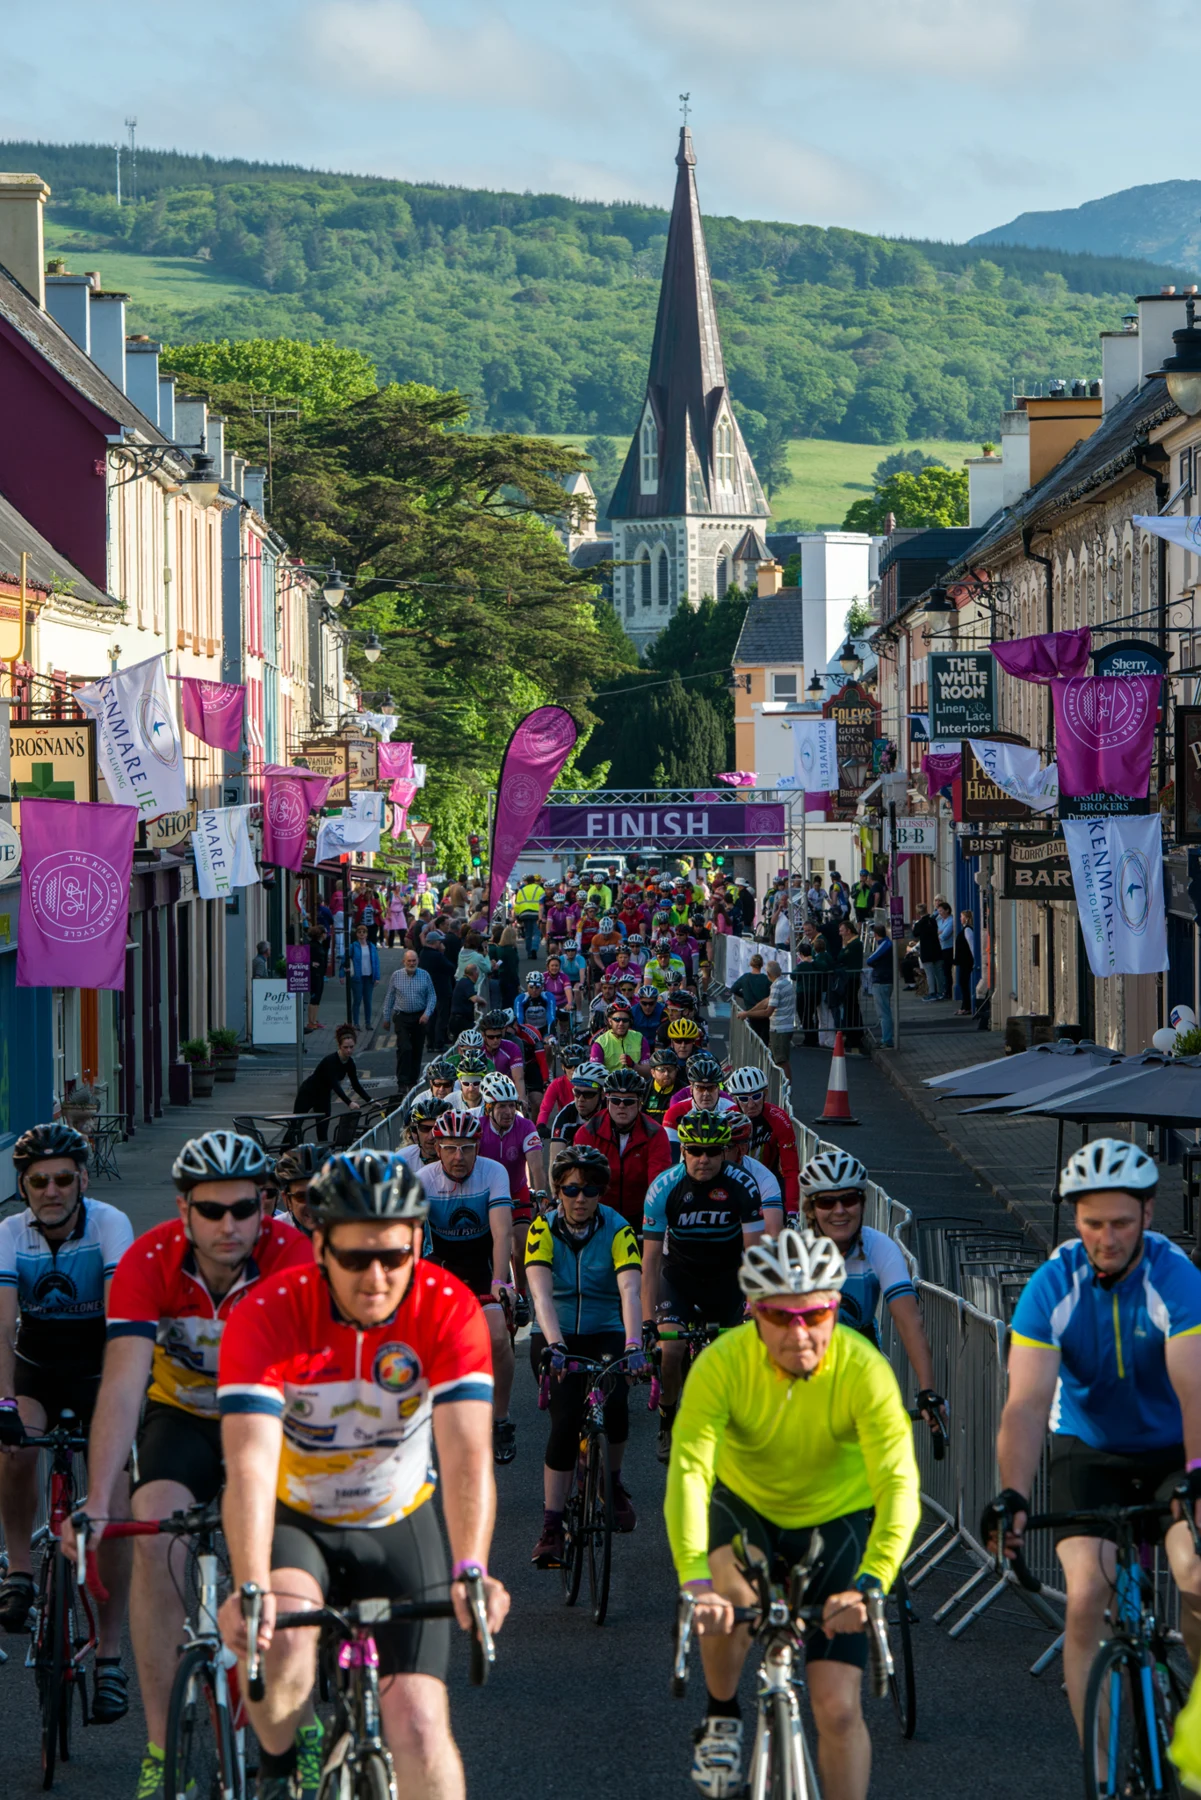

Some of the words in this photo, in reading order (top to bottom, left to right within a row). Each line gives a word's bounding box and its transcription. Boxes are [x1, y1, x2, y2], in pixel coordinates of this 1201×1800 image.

[947, 658, 977, 671] THE
[1112, 658, 1148, 672] Sherry
[937, 672, 988, 685] WHITE
[941, 686, 986, 699] ROOM
[935, 703, 966, 714] Linen
[1069, 687, 1079, 727] KENMARE
[831, 707, 872, 725] FOLEYS
[965, 711, 992, 721] Lace
[1121, 708, 1143, 736] BEARA
[936, 721, 991, 734] Interiors
[10, 731, 85, 758] BROSNAN'S
[95, 676, 158, 812] KENMARE.IE
[105, 742, 114, 756] TO
[109, 757, 127, 789] LIVING
[1080, 802, 1129, 811] BROKERS
[157, 811, 194, 838] SHOP
[586, 812, 709, 837] FINISH
[898, 828, 924, 844] B&B
[69, 855, 87, 863] THE
[1013, 846, 1045, 860] FLORRY
[92, 861, 112, 879] RING
[1015, 869, 1072, 887] BAR
[1081, 853, 1095, 890] ESCAPE
[31, 874, 41, 916] KENMARE
[110, 881, 118, 894] OF
[1088, 892, 1097, 906] TO
[99, 899, 118, 927] BEARA
[64, 928, 96, 938] CYCLE
[1091, 908, 1105, 943] LIVING
[264, 992, 290, 1003] Poffs
[645, 1168, 679, 1207] MCTC
[724, 1164, 760, 1199] MCTC
[678, 1211, 731, 1226] MCTC
